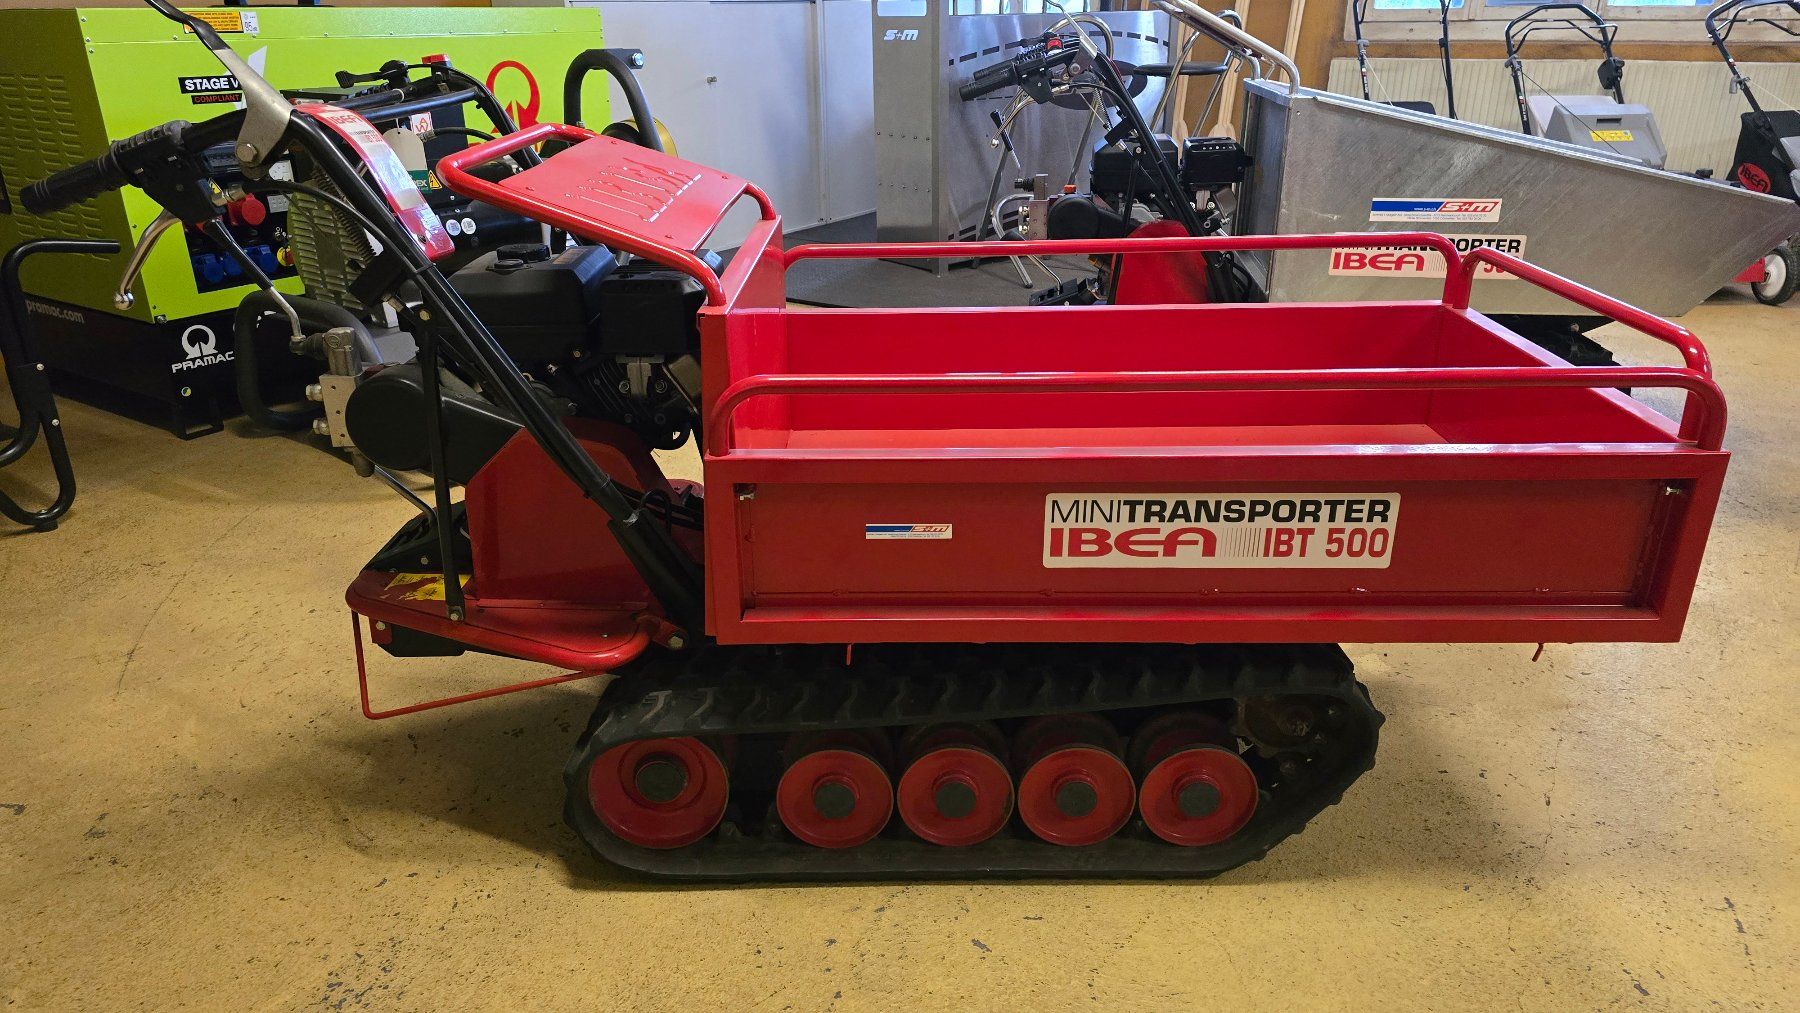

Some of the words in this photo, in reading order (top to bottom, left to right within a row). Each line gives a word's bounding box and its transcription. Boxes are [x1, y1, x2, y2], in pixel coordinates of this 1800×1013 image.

[184, 78, 230, 91] STAGE
[230, 78, 239, 88] V
[194, 94, 240, 103] COMPLIANT
[1740, 165, 1769, 193] IBEA
[1332, 252, 1425, 272] IBEA
[26, 300, 86, 324] pramac.com
[171, 350, 235, 374] PRAMAC
[1050, 499, 1391, 523] MINITRANSPORTER
[1049, 527, 1218, 558] IBEA
[1262, 527, 1316, 558] IBT
[1325, 527, 1390, 558] 500
